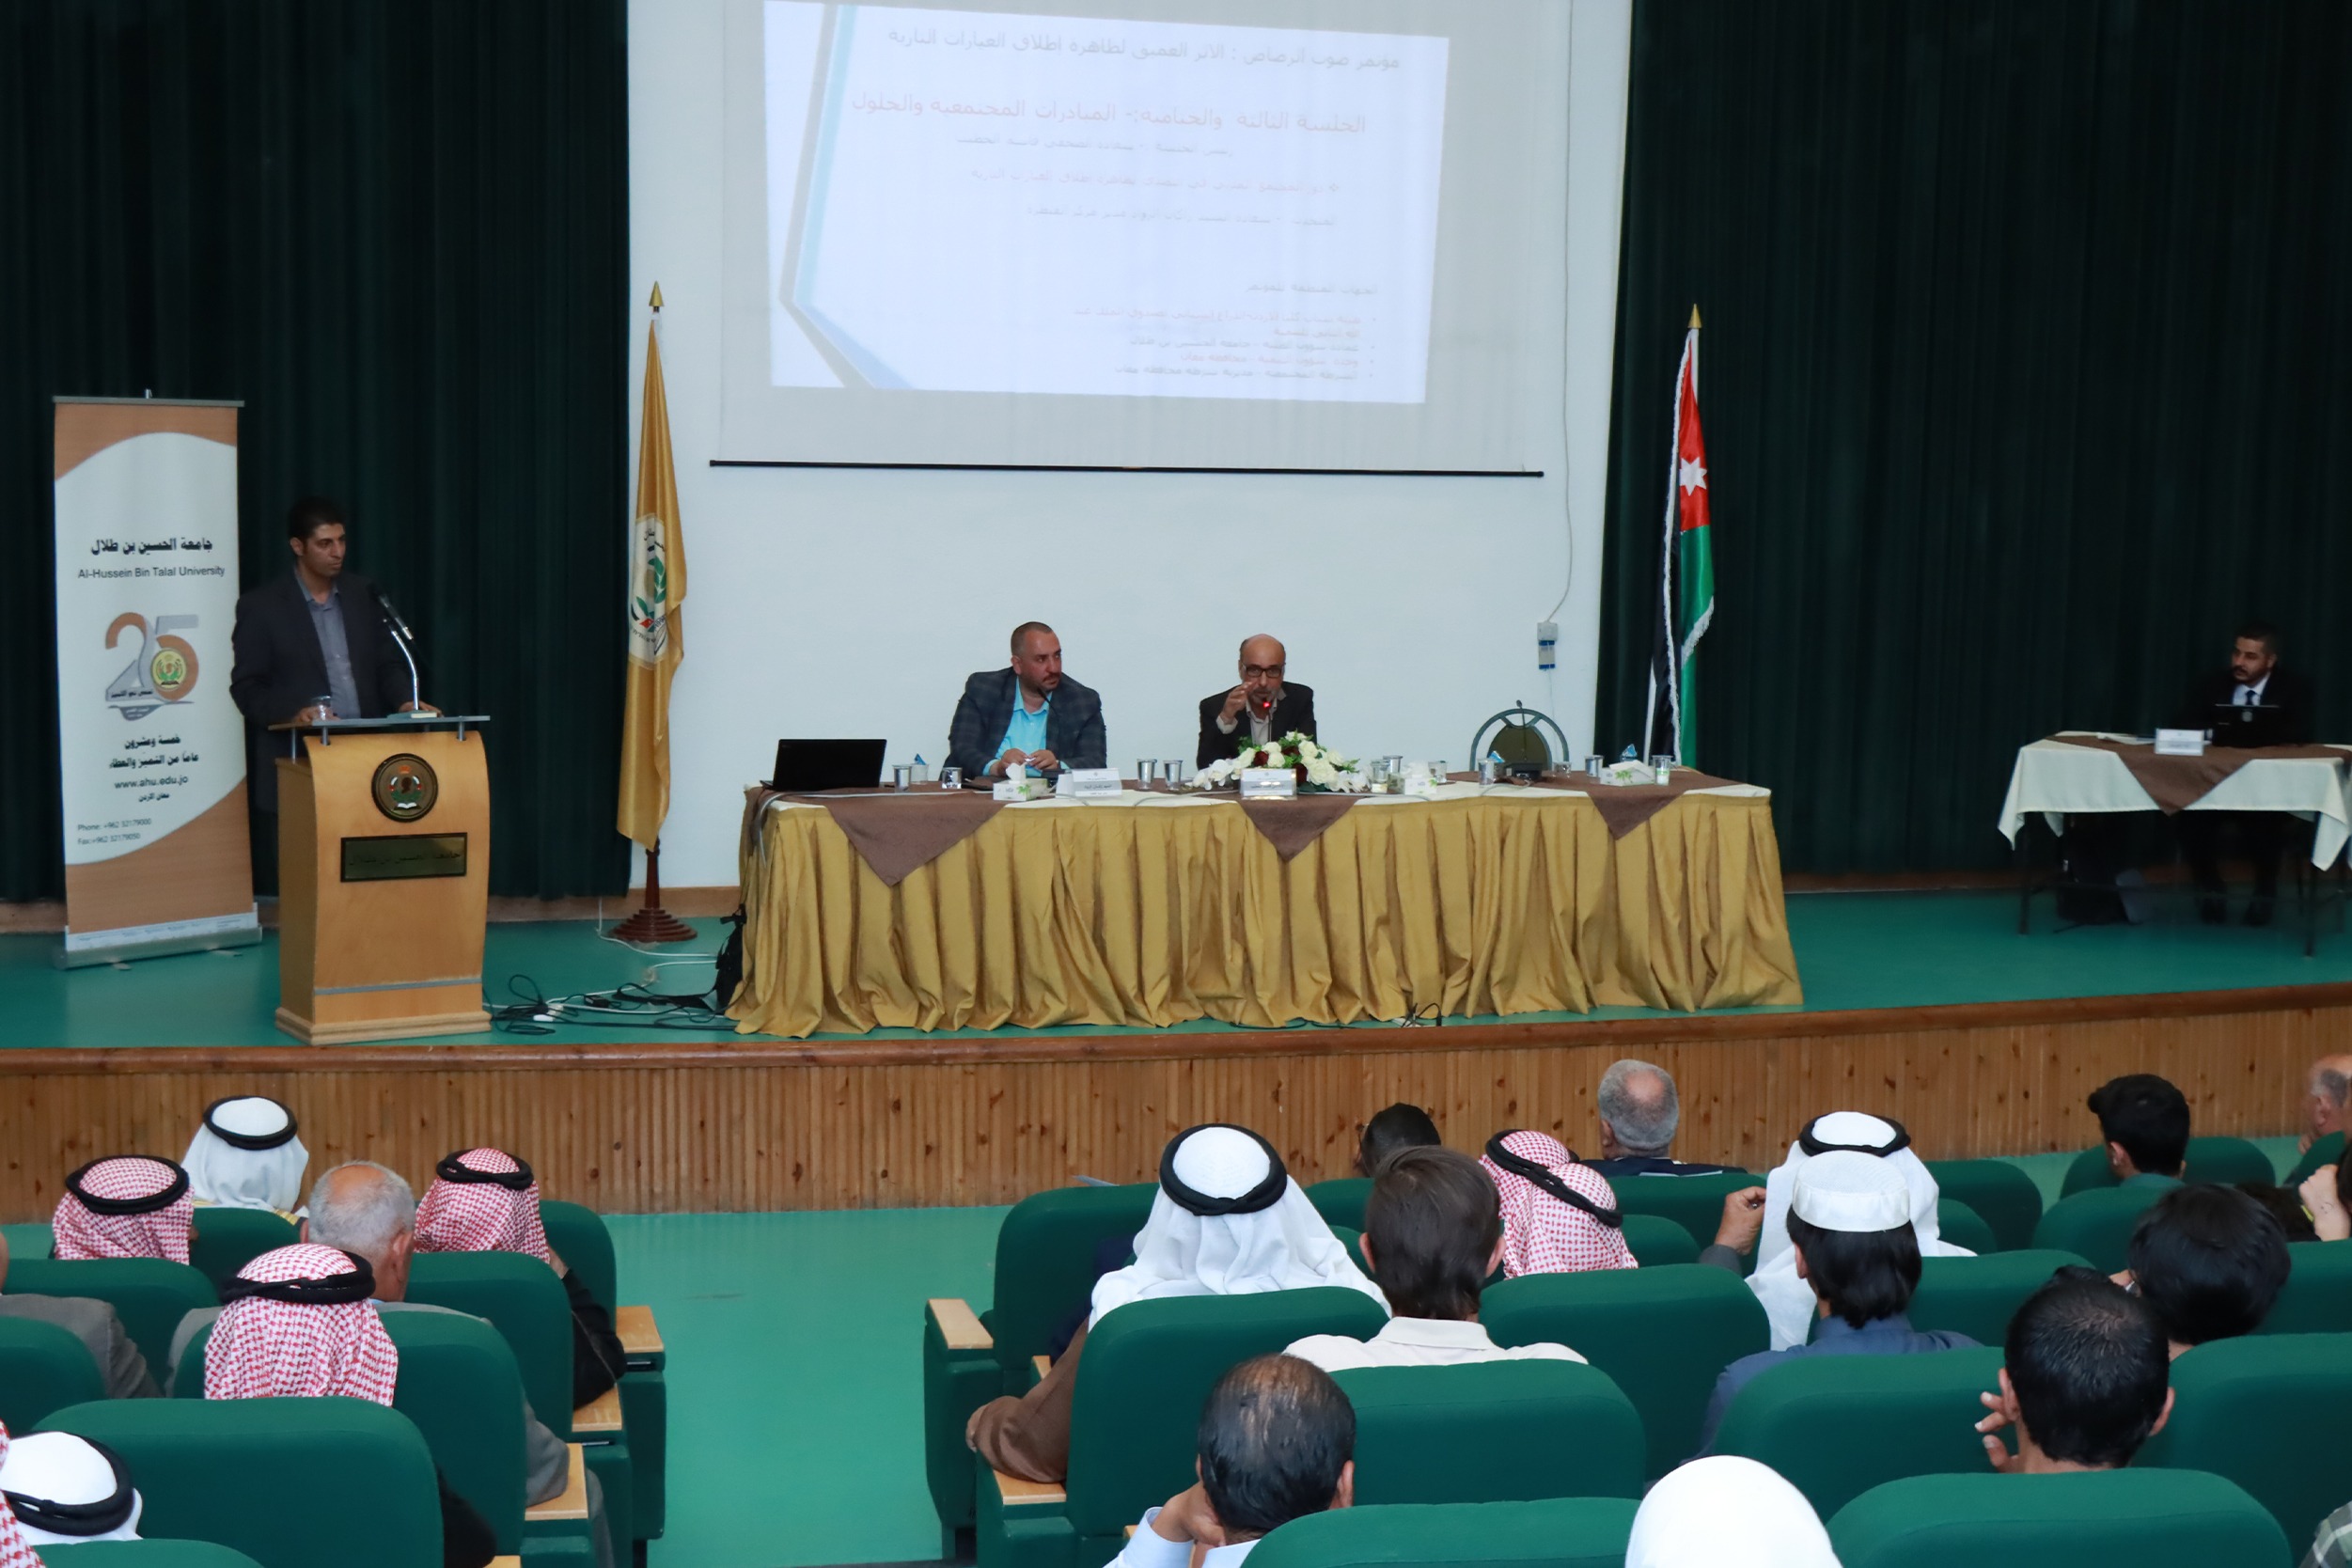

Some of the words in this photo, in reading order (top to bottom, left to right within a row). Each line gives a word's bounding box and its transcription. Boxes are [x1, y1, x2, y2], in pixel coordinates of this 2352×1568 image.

[1296, 113, 1367, 133] الجلسة
[91, 538, 119, 556] طلال
[122, 541, 135, 556] بن
[138, 537, 178, 556] الحسين
[180, 537, 213, 553] جامعة
[78, 568, 133, 579] Al-Hussein
[134, 567, 150, 577] Bin
[153, 566, 177, 576] Talal
[179, 564, 226, 578] University
[124, 736, 156, 750] وعشرون
[158, 733, 181, 745] خمسة
[167, 755, 180, 766] من
[115, 776, 189, 790] www.ahu.edu.jo
